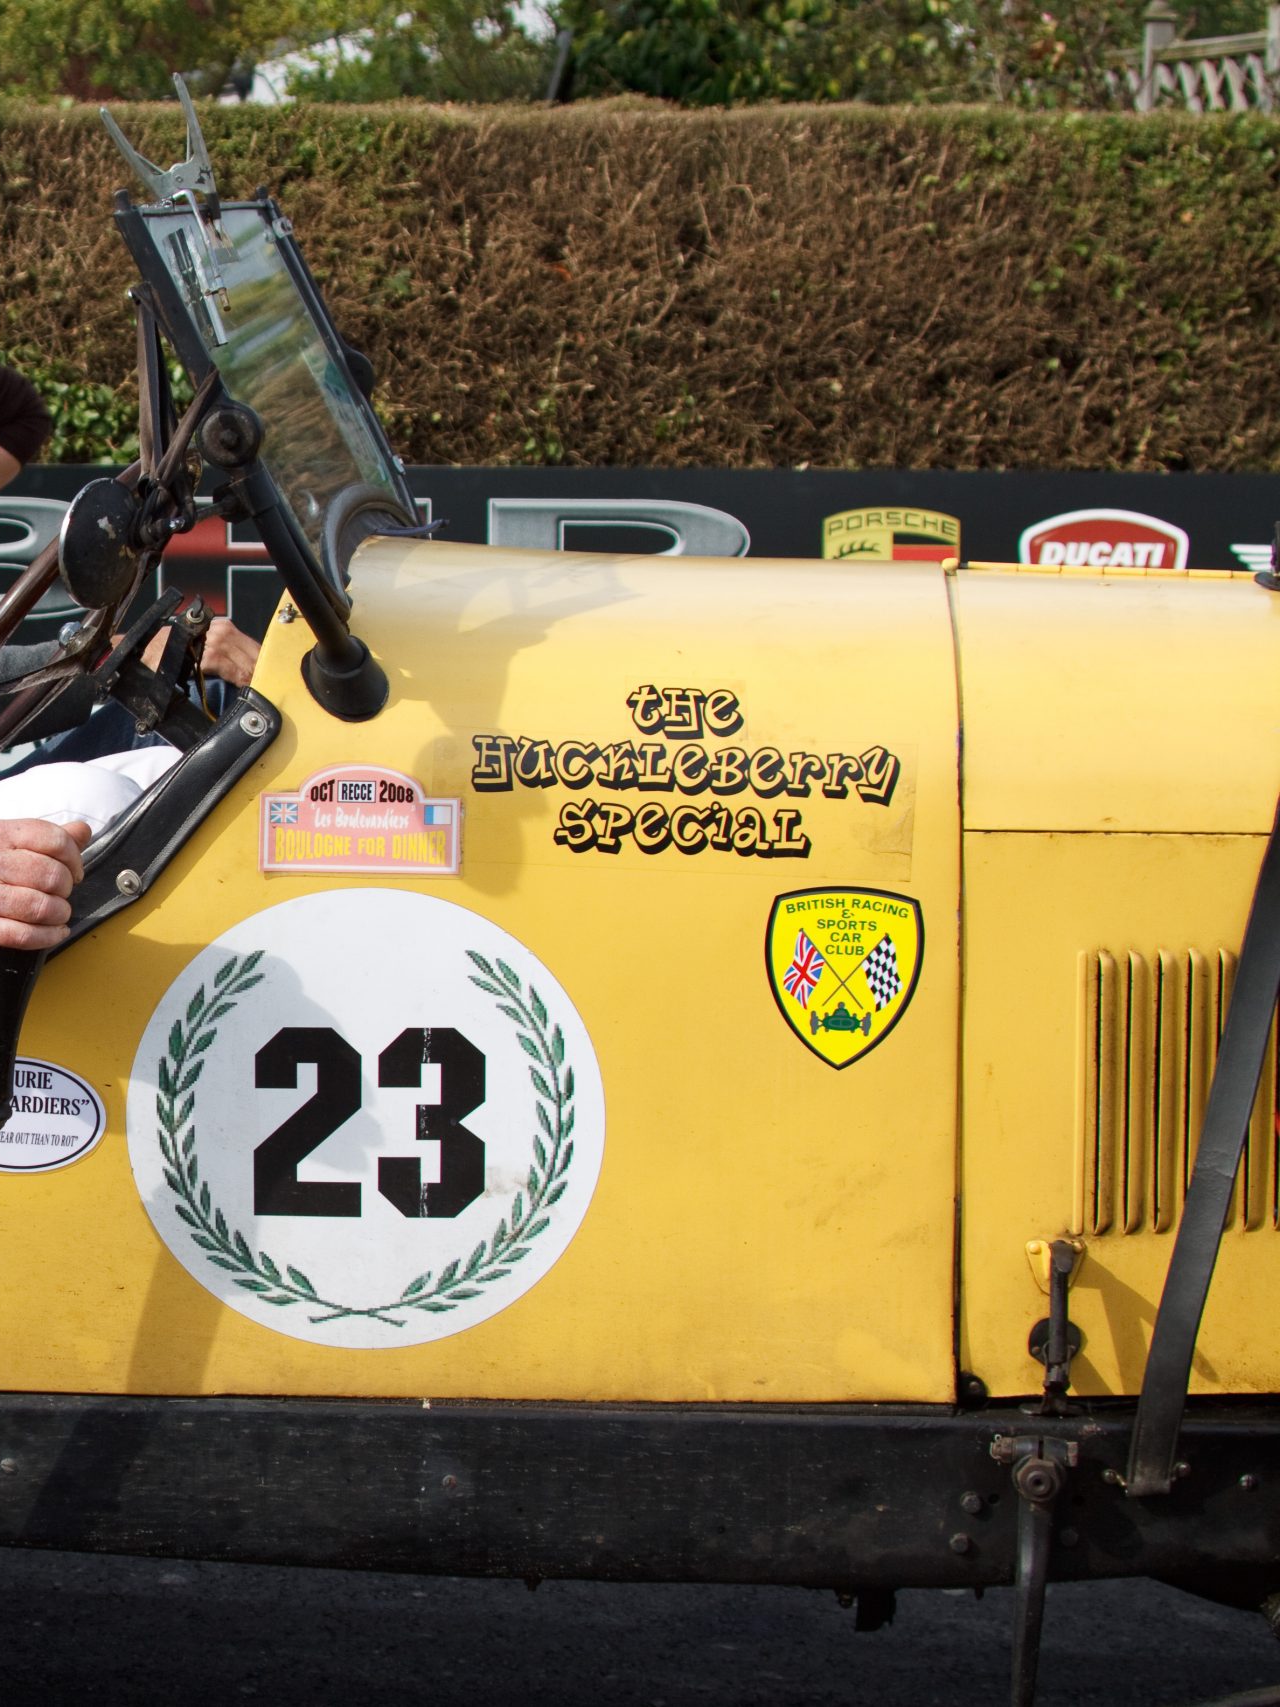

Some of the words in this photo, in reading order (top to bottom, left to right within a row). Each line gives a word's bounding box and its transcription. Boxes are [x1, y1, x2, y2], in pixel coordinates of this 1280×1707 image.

[828, 511, 958, 537] PORSCHE
[1039, 541, 1166, 567] DUCATI
[310, 779, 335, 802] OCT
[341, 783, 373, 801] RECCE
[379, 780, 414, 803] 2008
[275, 827, 352, 863] BOULOGNE
[357, 836, 385, 858] FOR
[392, 830, 447, 865] DINNER
[786, 898, 845, 914] BRITISH
[852, 898, 909, 919] RACING
[841, 909, 855, 919] &
[816, 919, 877, 931] SPORTS
[830, 932, 862, 943] CAR
[825, 944, 865, 955] CLUB
[15, 1070, 53, 1089] URIE
[253, 1027, 486, 1219] 23
[16, 1132, 30, 1144] OUT
[31, 1133, 49, 1146] THAN
[51, 1134, 60, 1146] TO
